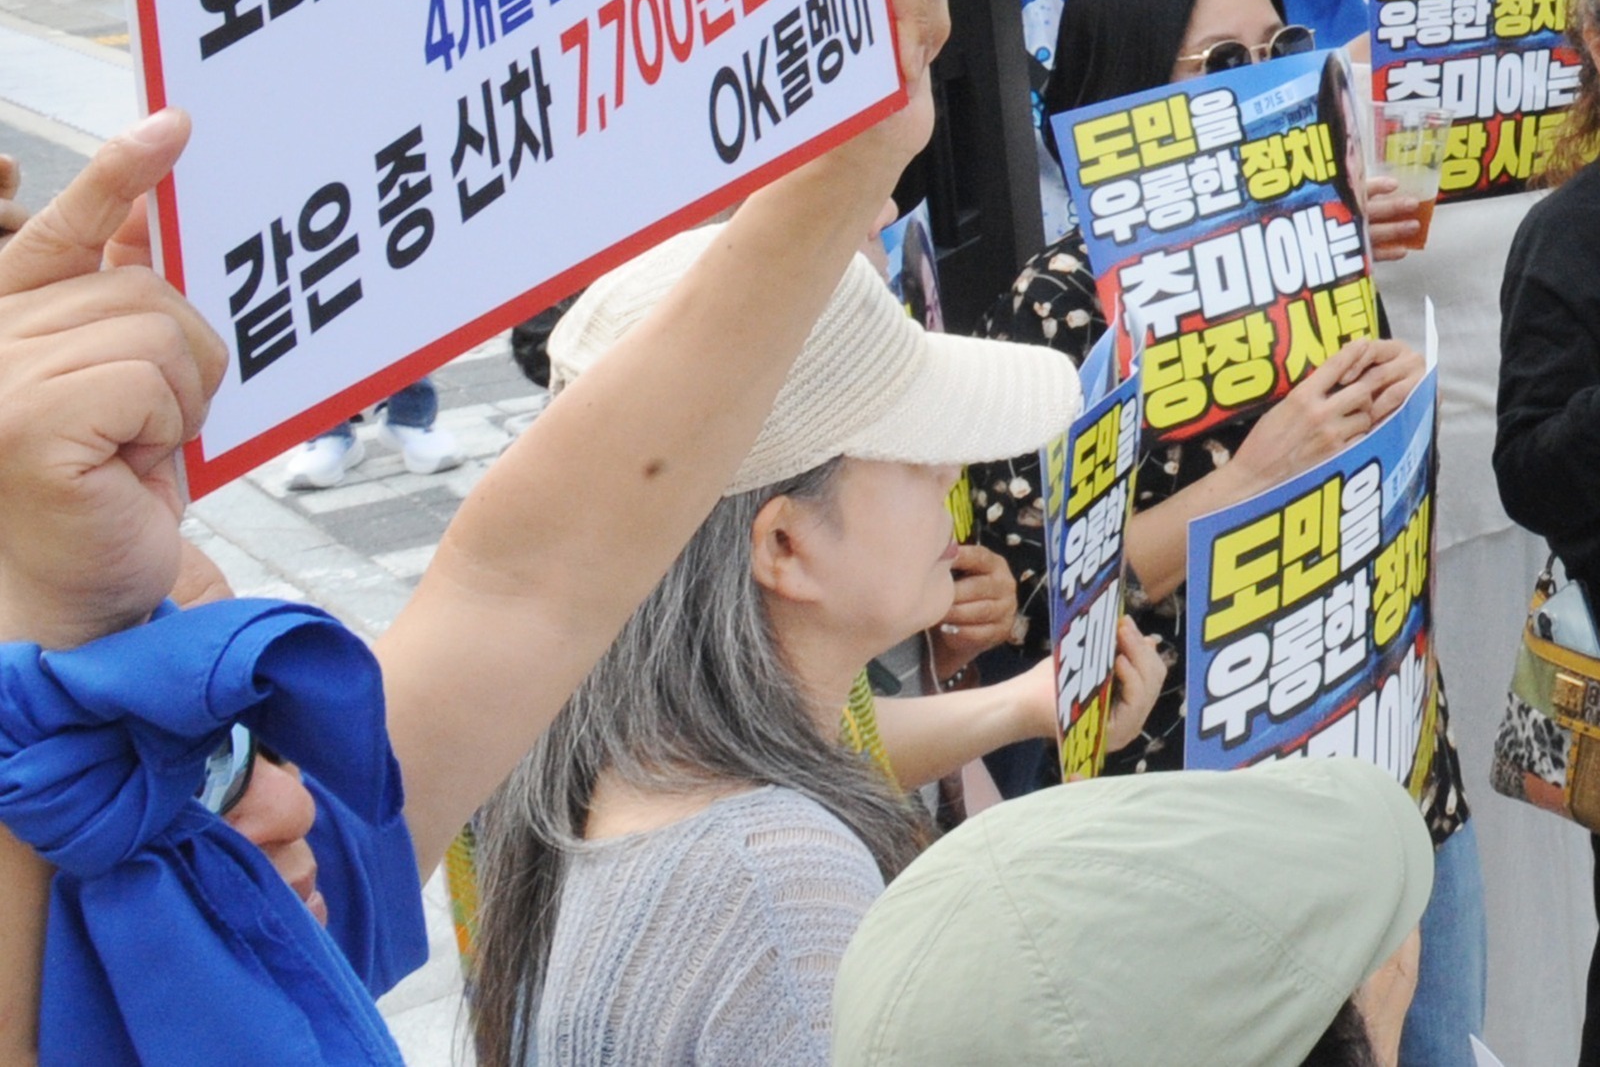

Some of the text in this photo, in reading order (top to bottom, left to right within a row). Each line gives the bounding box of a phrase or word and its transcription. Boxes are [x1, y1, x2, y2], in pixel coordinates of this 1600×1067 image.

[1072, 87, 1244, 186] 도민을
[1384, 48, 1585, 126] 추미애는
[224, 178, 364, 385] 같은
[374, 123, 436, 272] 종
[449, 46, 556, 224] 신차
[1088, 122, 1338, 244] 우롱한 정치!
[1119, 205, 1365, 339] 추미애는
[1142, 312, 1277, 430] 당장
[1065, 396, 1138, 521] 도민을
[1060, 478, 1127, 602] 우롱한
[1203, 461, 1381, 644] 도민을
[1201, 571, 1371, 742] 우롱한
[1372, 491, 1431, 648] 정치!
